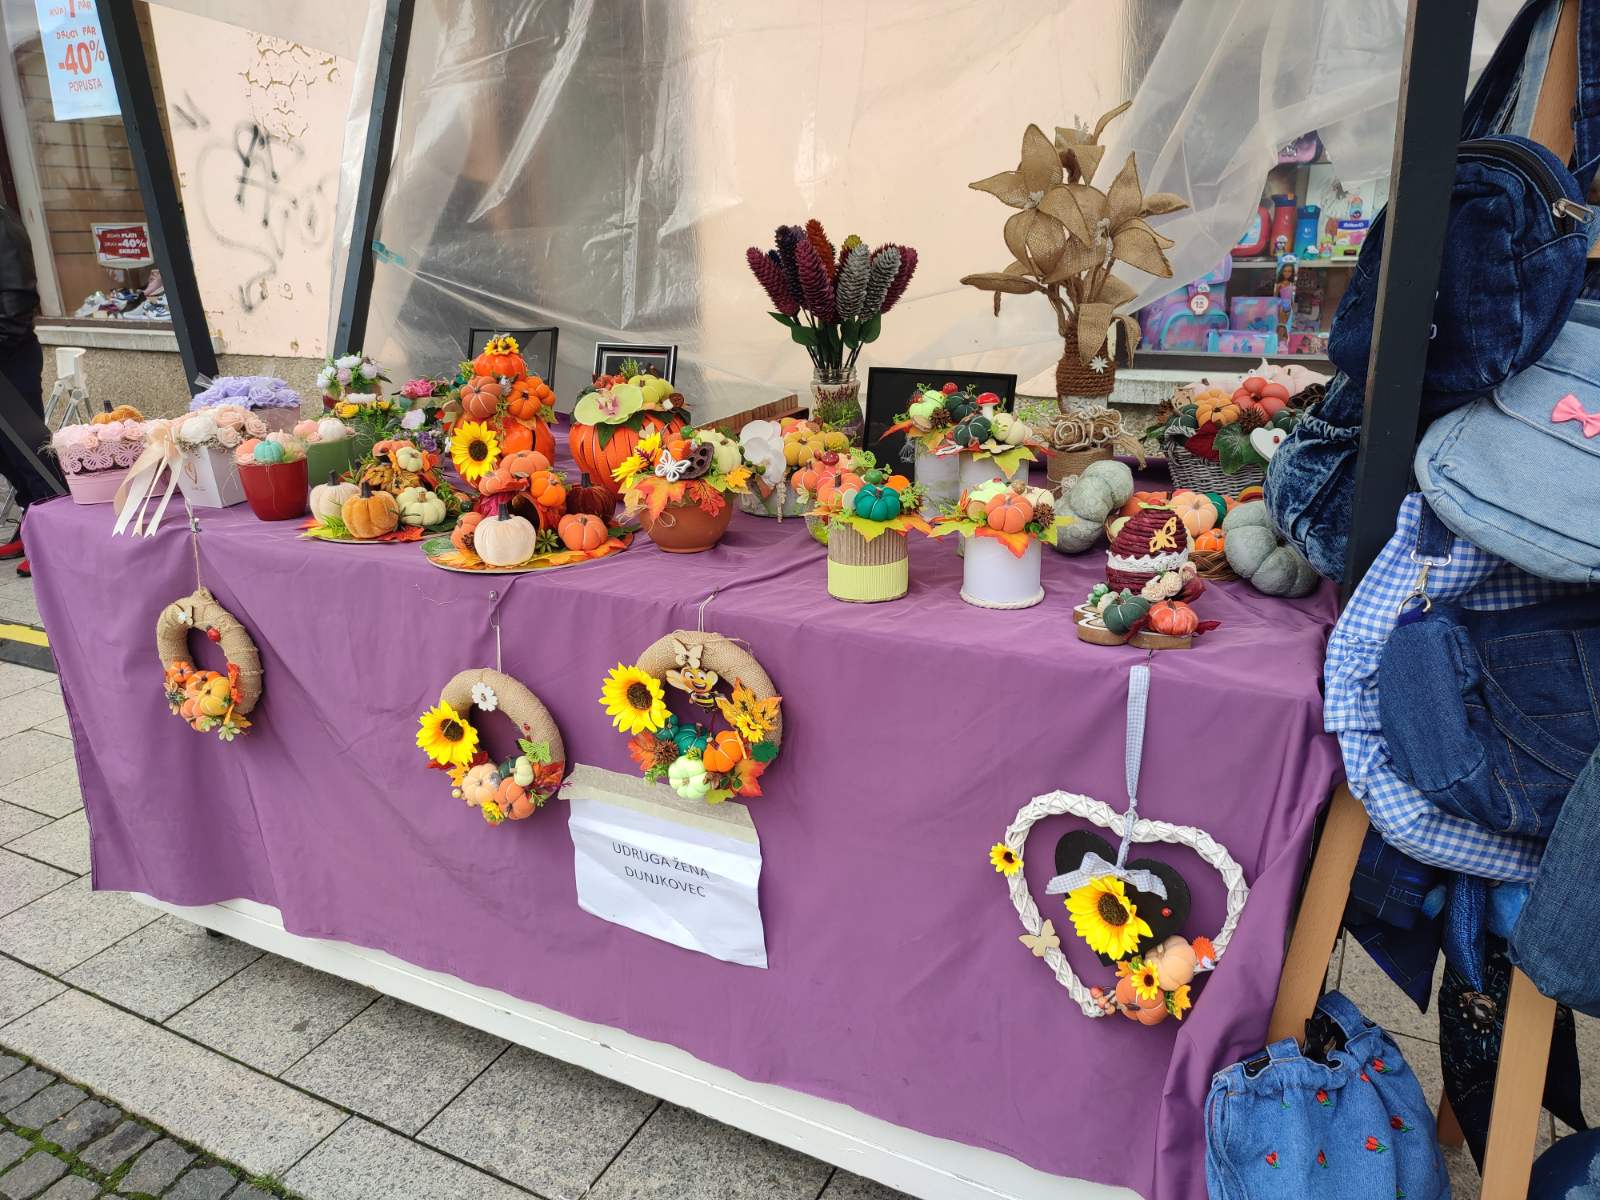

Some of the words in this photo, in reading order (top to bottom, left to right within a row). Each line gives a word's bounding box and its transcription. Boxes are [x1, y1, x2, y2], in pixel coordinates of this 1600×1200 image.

[83, 26, 97, 36] PAR
[58, 40, 105, 75] -40%
[69, 78, 103, 92] POPUSTA
[612, 841, 671, 867] UDRUGA
[673, 857, 710, 879] ŽENA
[624, 866, 706, 898] DUNJKOVEC
